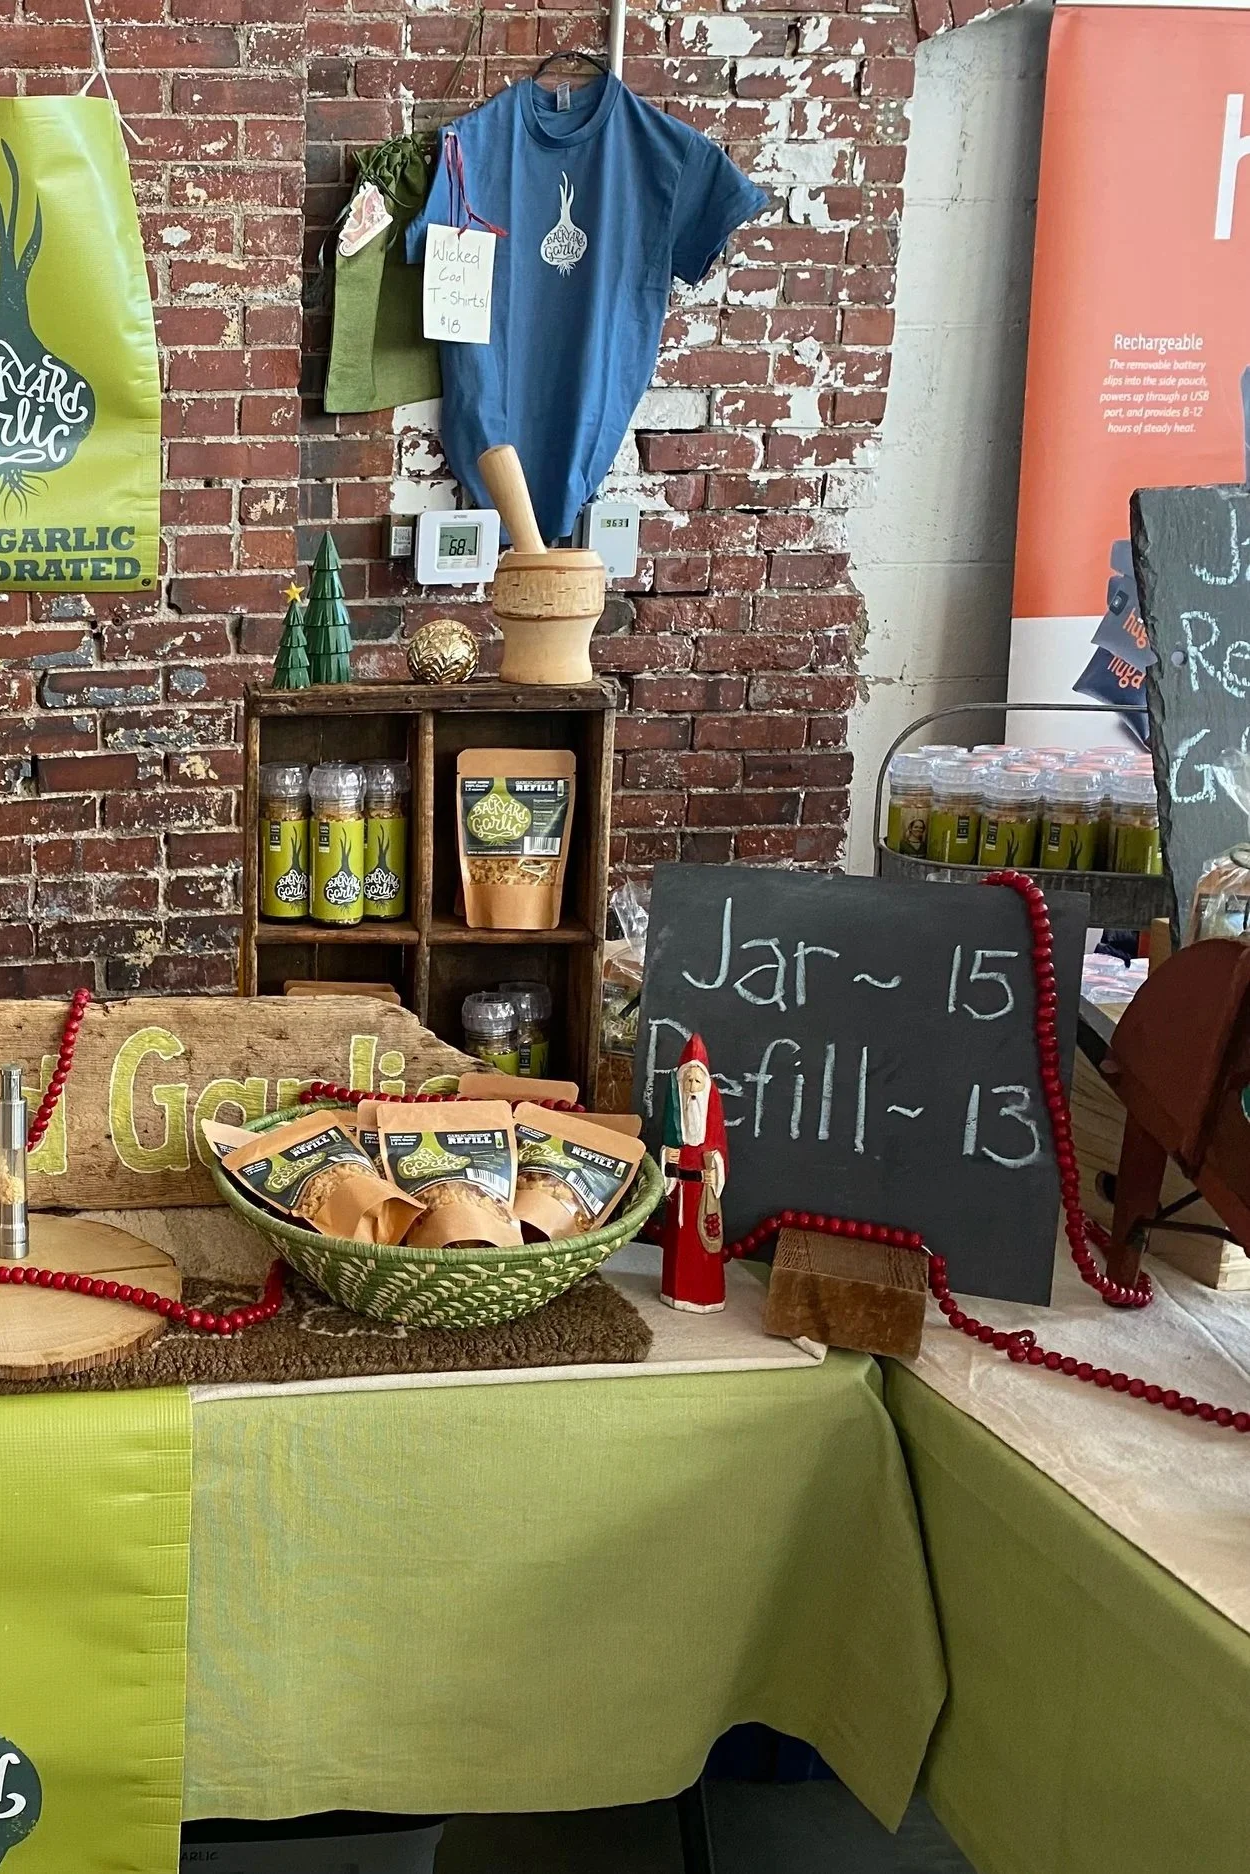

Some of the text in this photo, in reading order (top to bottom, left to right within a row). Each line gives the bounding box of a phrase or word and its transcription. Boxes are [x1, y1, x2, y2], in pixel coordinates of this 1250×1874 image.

[433, 240, 481, 269] Wicked
[545, 241, 582, 262] Garlic
[439, 267, 465, 285] Cool
[441, 314, 461, 334] $18
[1114, 333, 1203, 355] Rechargeable
[1109, 359, 1206, 372] The removable battery
[1102, 375, 1123, 387] slips
[1125, 376, 1141, 385] into
[1143, 375, 1157, 385] the
[1158, 375, 1177, 385] side
[1100, 392, 1132, 404] powers
[1133, 393, 1145, 403] up
[1146, 391, 1180, 403] through
[1190, 391, 1210, 401] USB
[1126, 407, 1143, 417] and
[1144, 407, 1181, 419] provides
[1107, 422, 1196, 435] hours of steady heat.
[449, 539, 466, 555] 68
[515, 784, 555, 792] REFILL
[472, 815, 522, 838] Garlic
[681, 897, 840, 1012] Jar
[947, 944, 1020, 1021] 15
[961, 1084, 1042, 1169] 13
[291, 1135, 331, 1157] REFILL
[447, 1136, 492, 1145] REFILL
